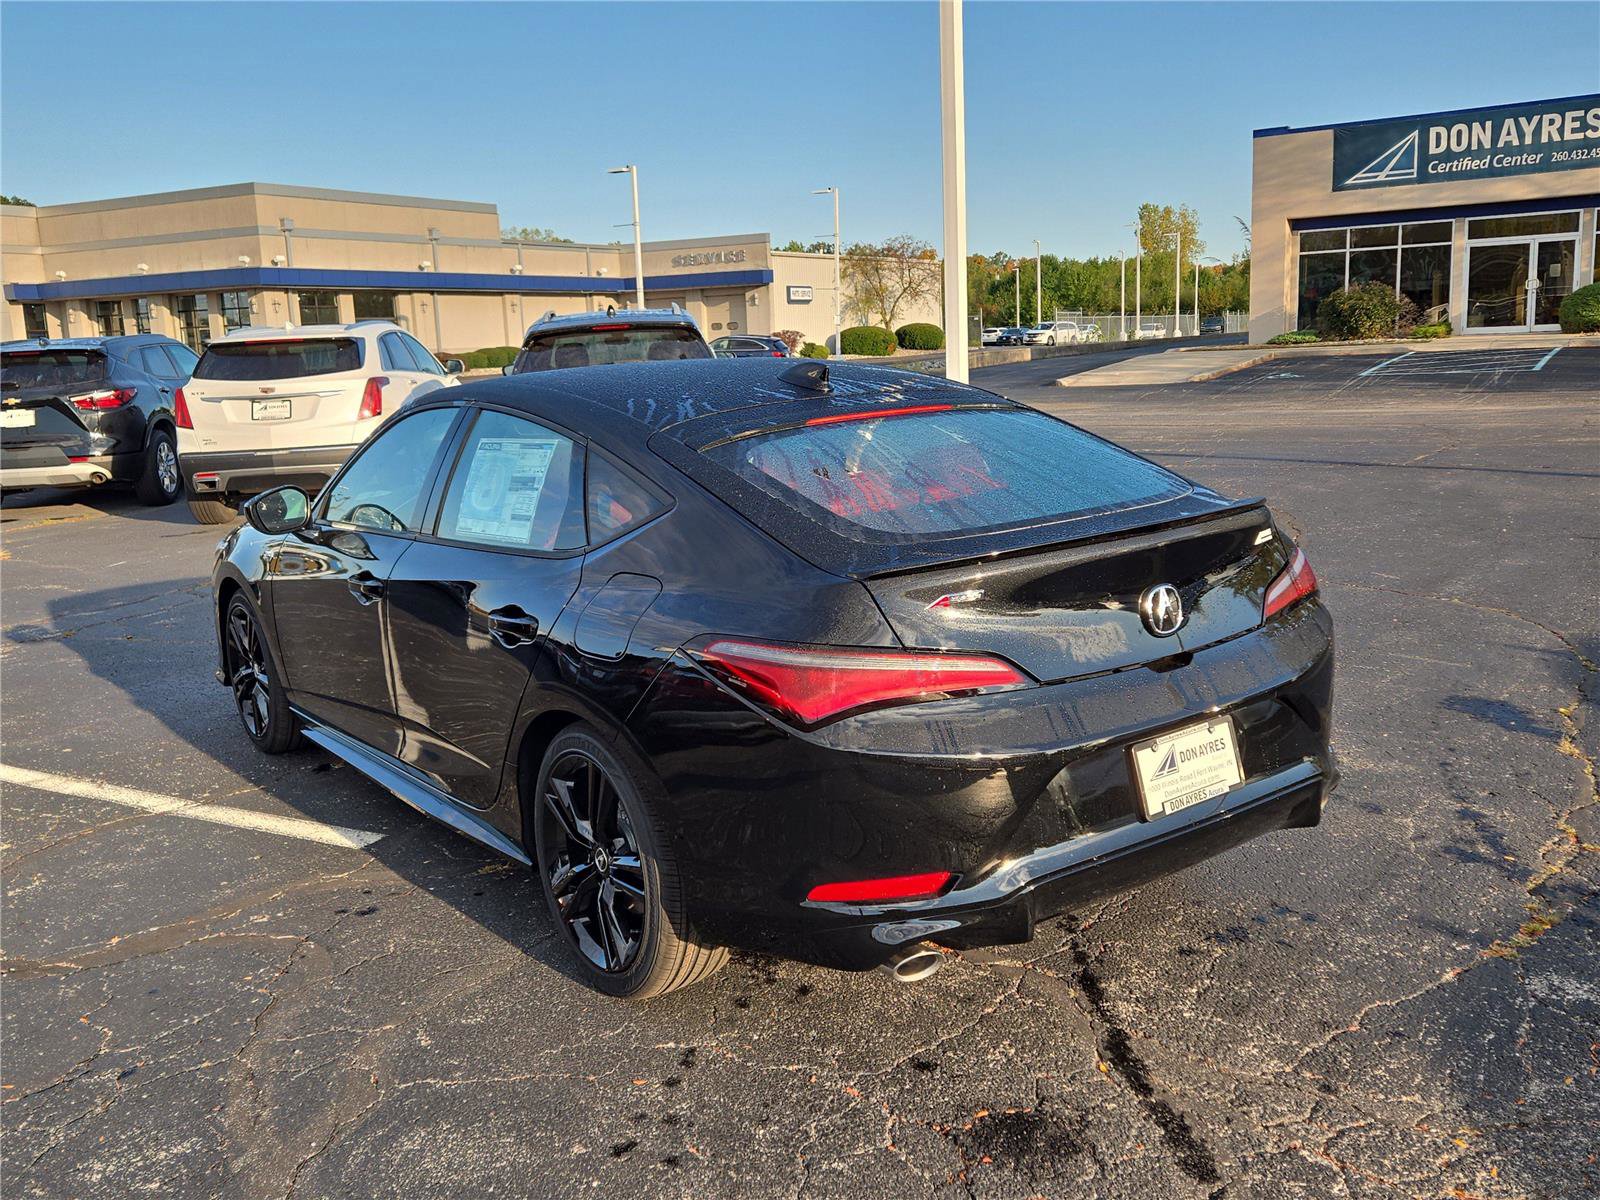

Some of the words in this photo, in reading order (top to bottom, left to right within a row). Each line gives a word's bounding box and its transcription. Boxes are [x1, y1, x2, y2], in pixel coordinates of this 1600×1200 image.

[1428, 120, 1492, 155] DON
[1497, 107, 1600, 148] AYRES
[1428, 155, 1491, 174] Certified
[1493, 152, 1544, 167] Center
[671, 249, 746, 268] SERVICE
[1179, 746, 1198, 763] DON
[1199, 737, 1226, 758] AYRES
[1169, 797, 1185, 812] DON
[1185, 788, 1207, 805] AYRES
